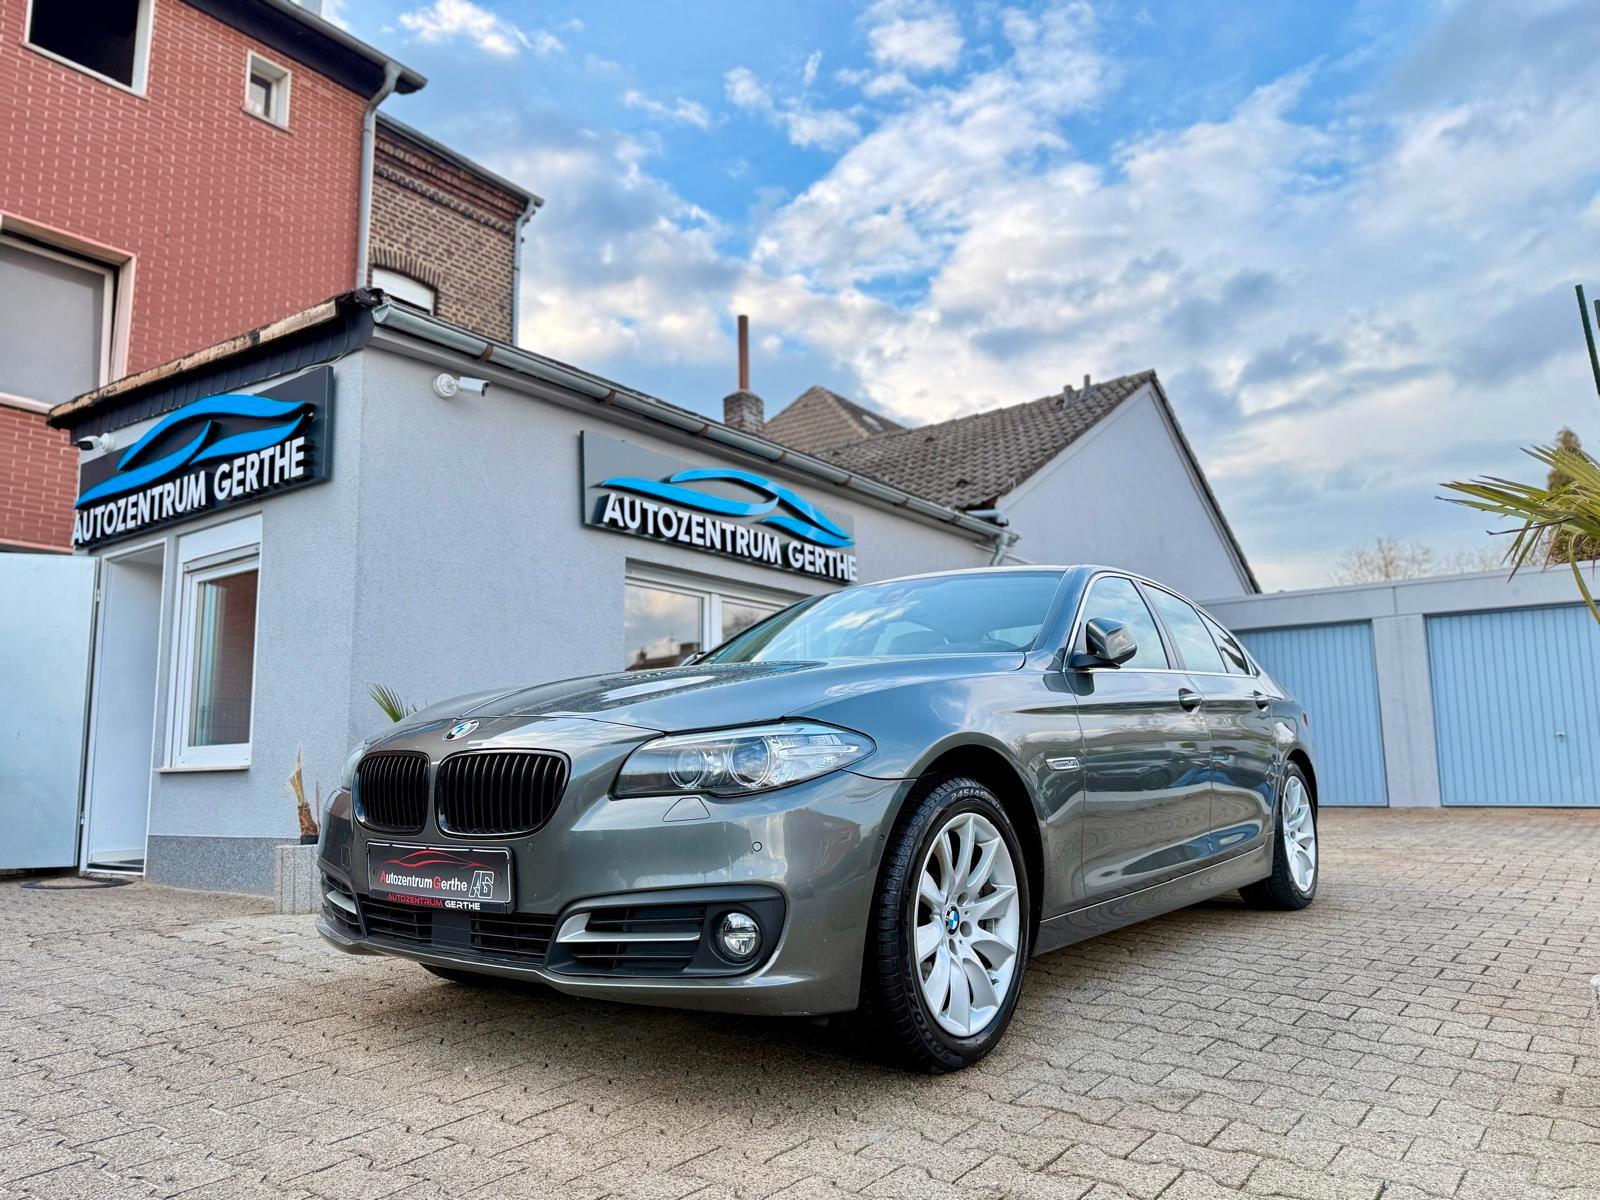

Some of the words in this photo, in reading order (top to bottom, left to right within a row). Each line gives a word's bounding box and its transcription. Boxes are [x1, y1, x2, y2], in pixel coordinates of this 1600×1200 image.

[72, 471, 206, 545] AUTOZENTRUM
[213, 437, 305, 500] GERTHE
[603, 493, 782, 564] AUTOZENTRUM
[788, 542, 858, 581] GERTHE
[387, 893, 443, 907] AUTOZENTRUM
[444, 900, 481, 910] GERTHE
